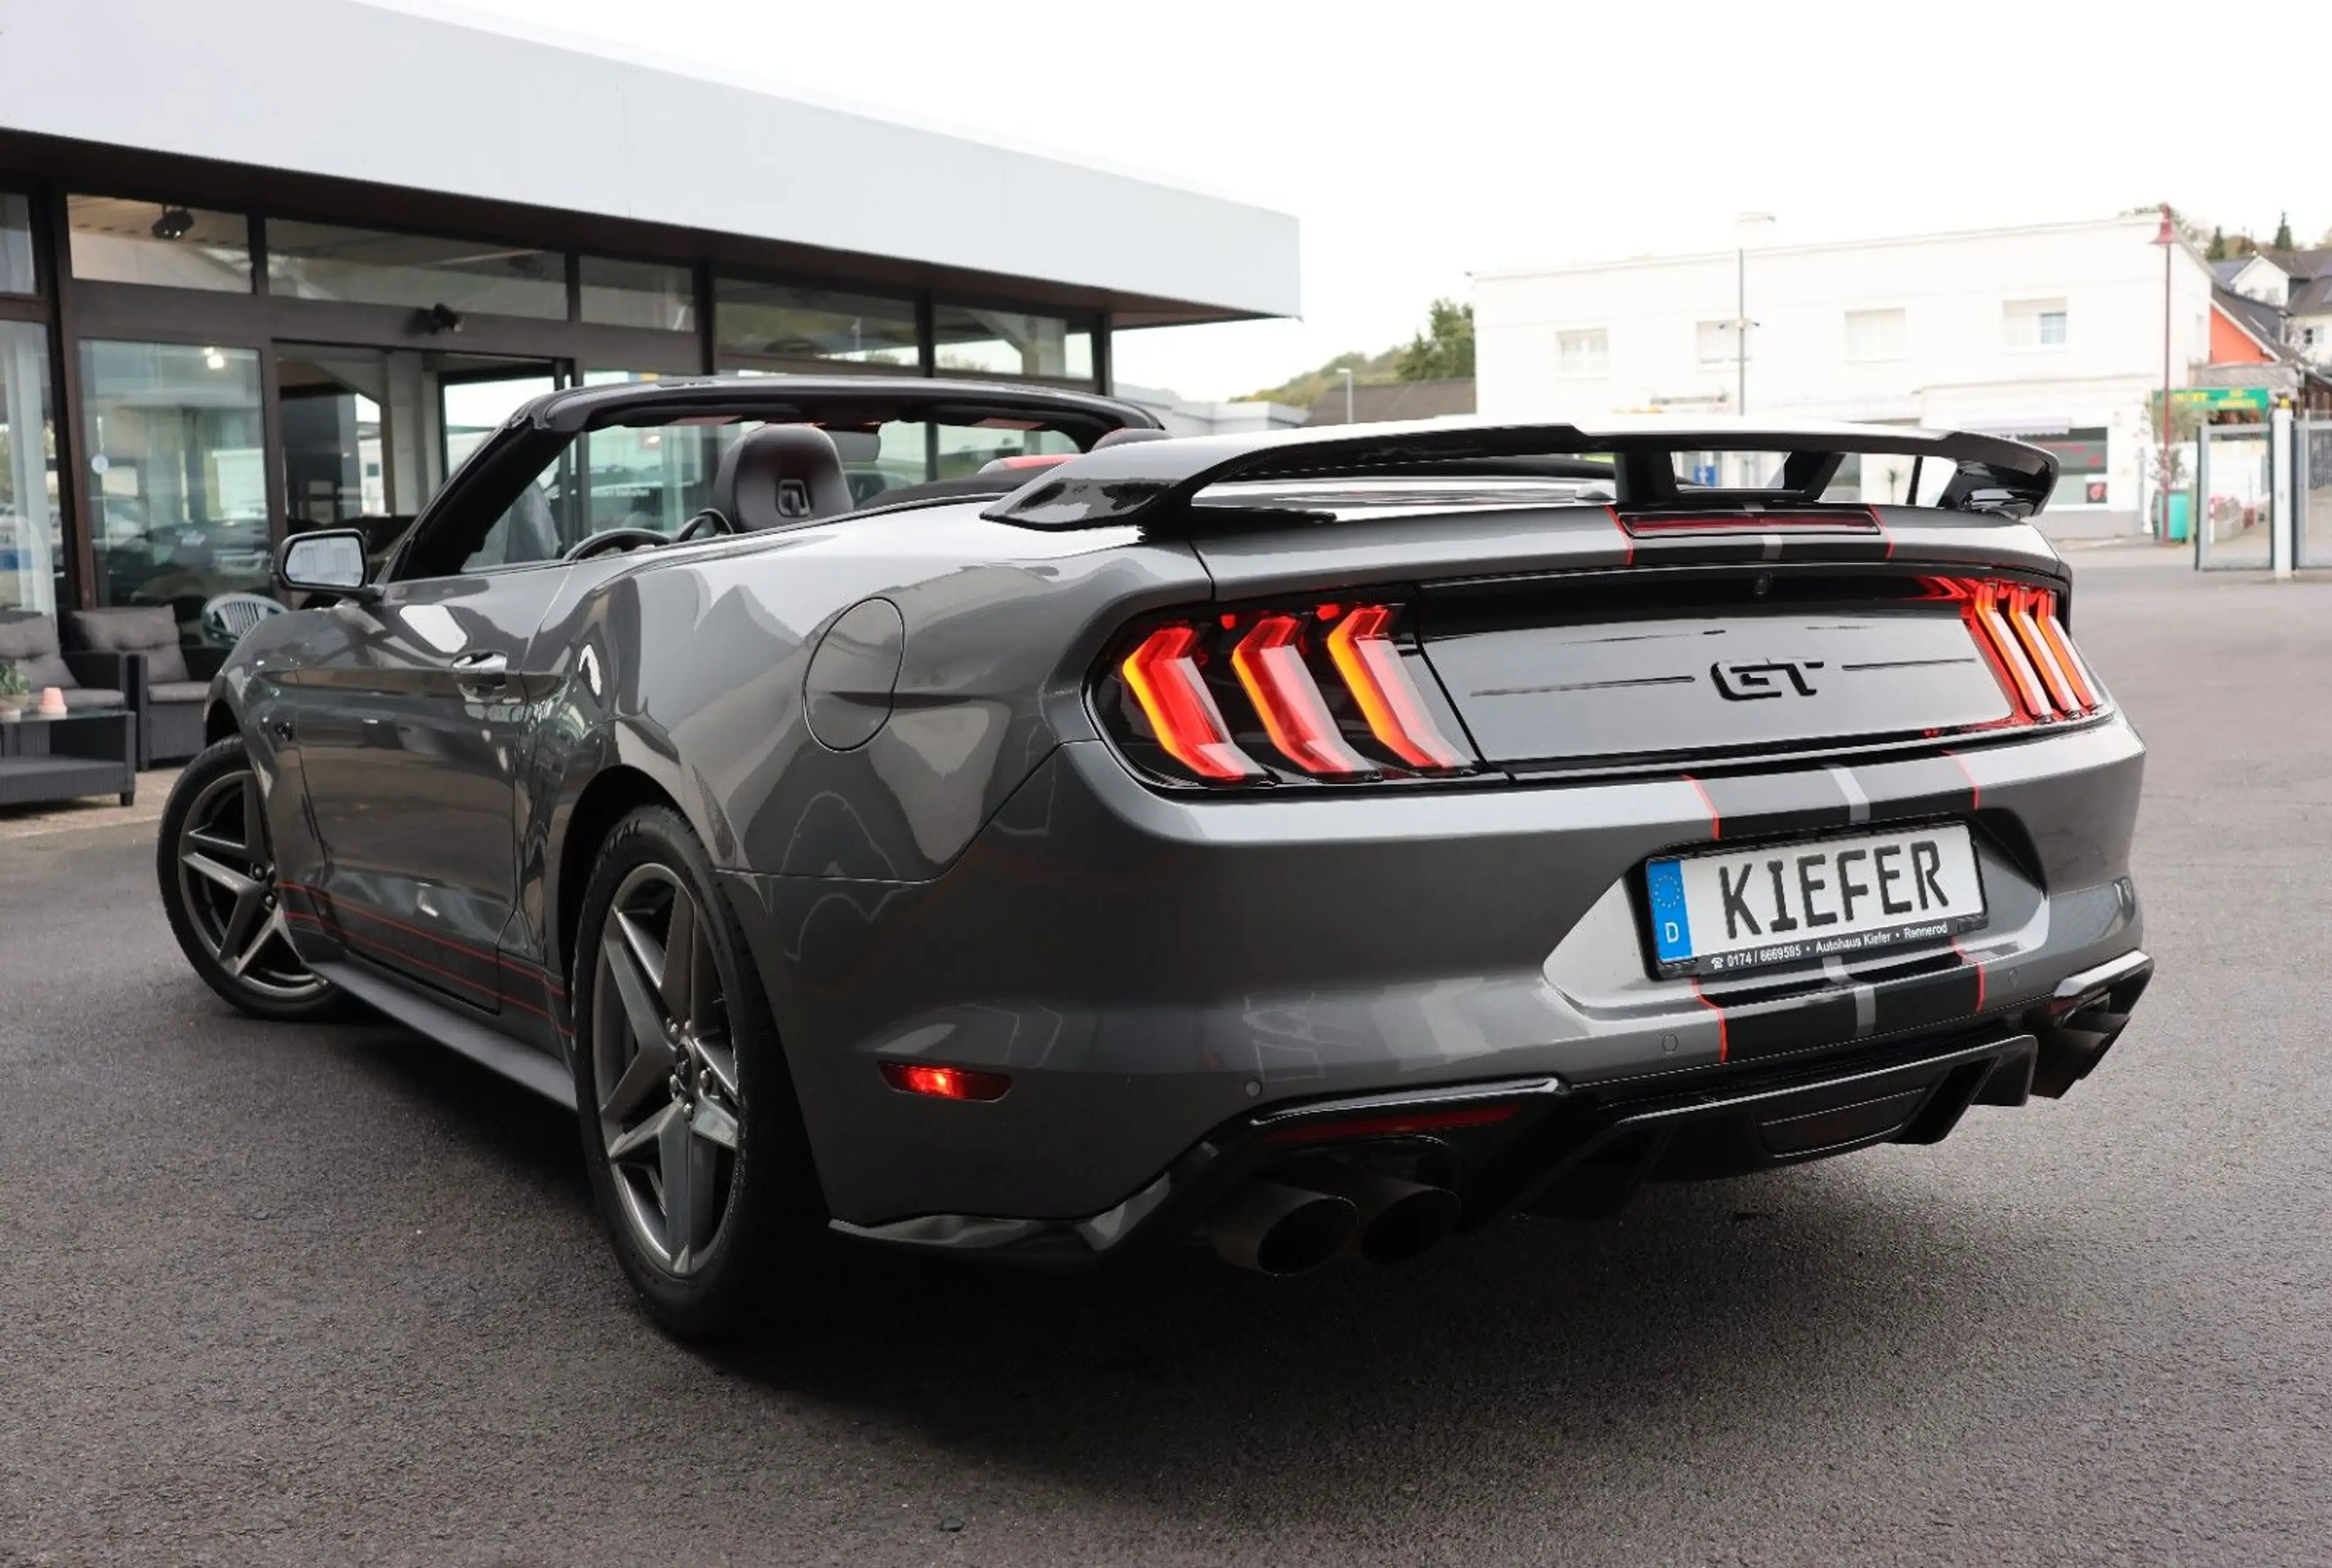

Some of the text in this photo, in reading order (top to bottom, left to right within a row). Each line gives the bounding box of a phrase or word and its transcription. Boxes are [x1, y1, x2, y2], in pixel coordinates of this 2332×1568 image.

[1710, 661, 1824, 701] GT
[1719, 840, 1949, 939] KIEFER
[1666, 921, 1679, 943] D
[1727, 951, 1753, 967] 0174
[1815, 937, 1862, 953] Autohaus
[1862, 931, 1892, 947] Kiefer
[1903, 921, 1948, 939] Rennerod
